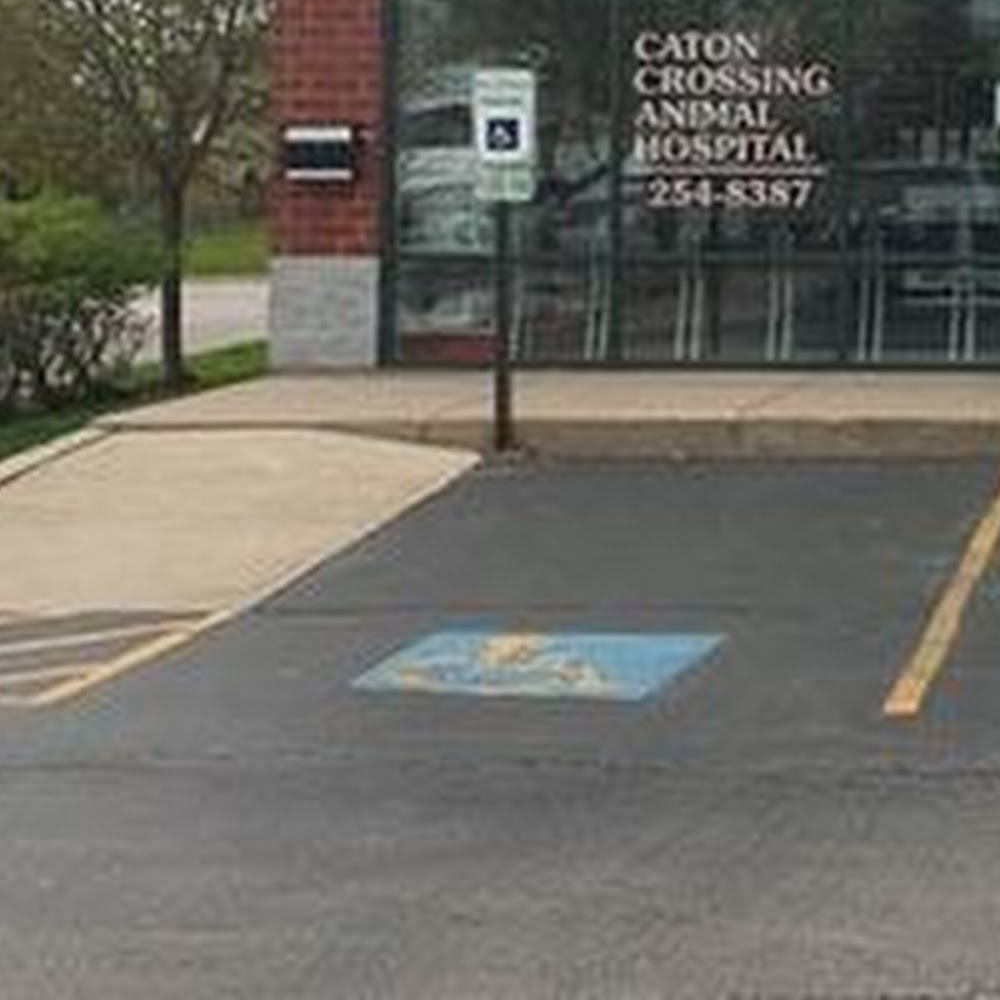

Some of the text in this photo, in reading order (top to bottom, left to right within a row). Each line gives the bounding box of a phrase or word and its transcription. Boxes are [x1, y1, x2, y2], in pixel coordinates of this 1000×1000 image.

[633, 31, 759, 60] CATON
[633, 63, 832, 95] CROSSING
[634, 100, 779, 129] ANIMAL
[633, 133, 818, 162] HOSPITAL
[648, 178, 812, 208] 254-8387
